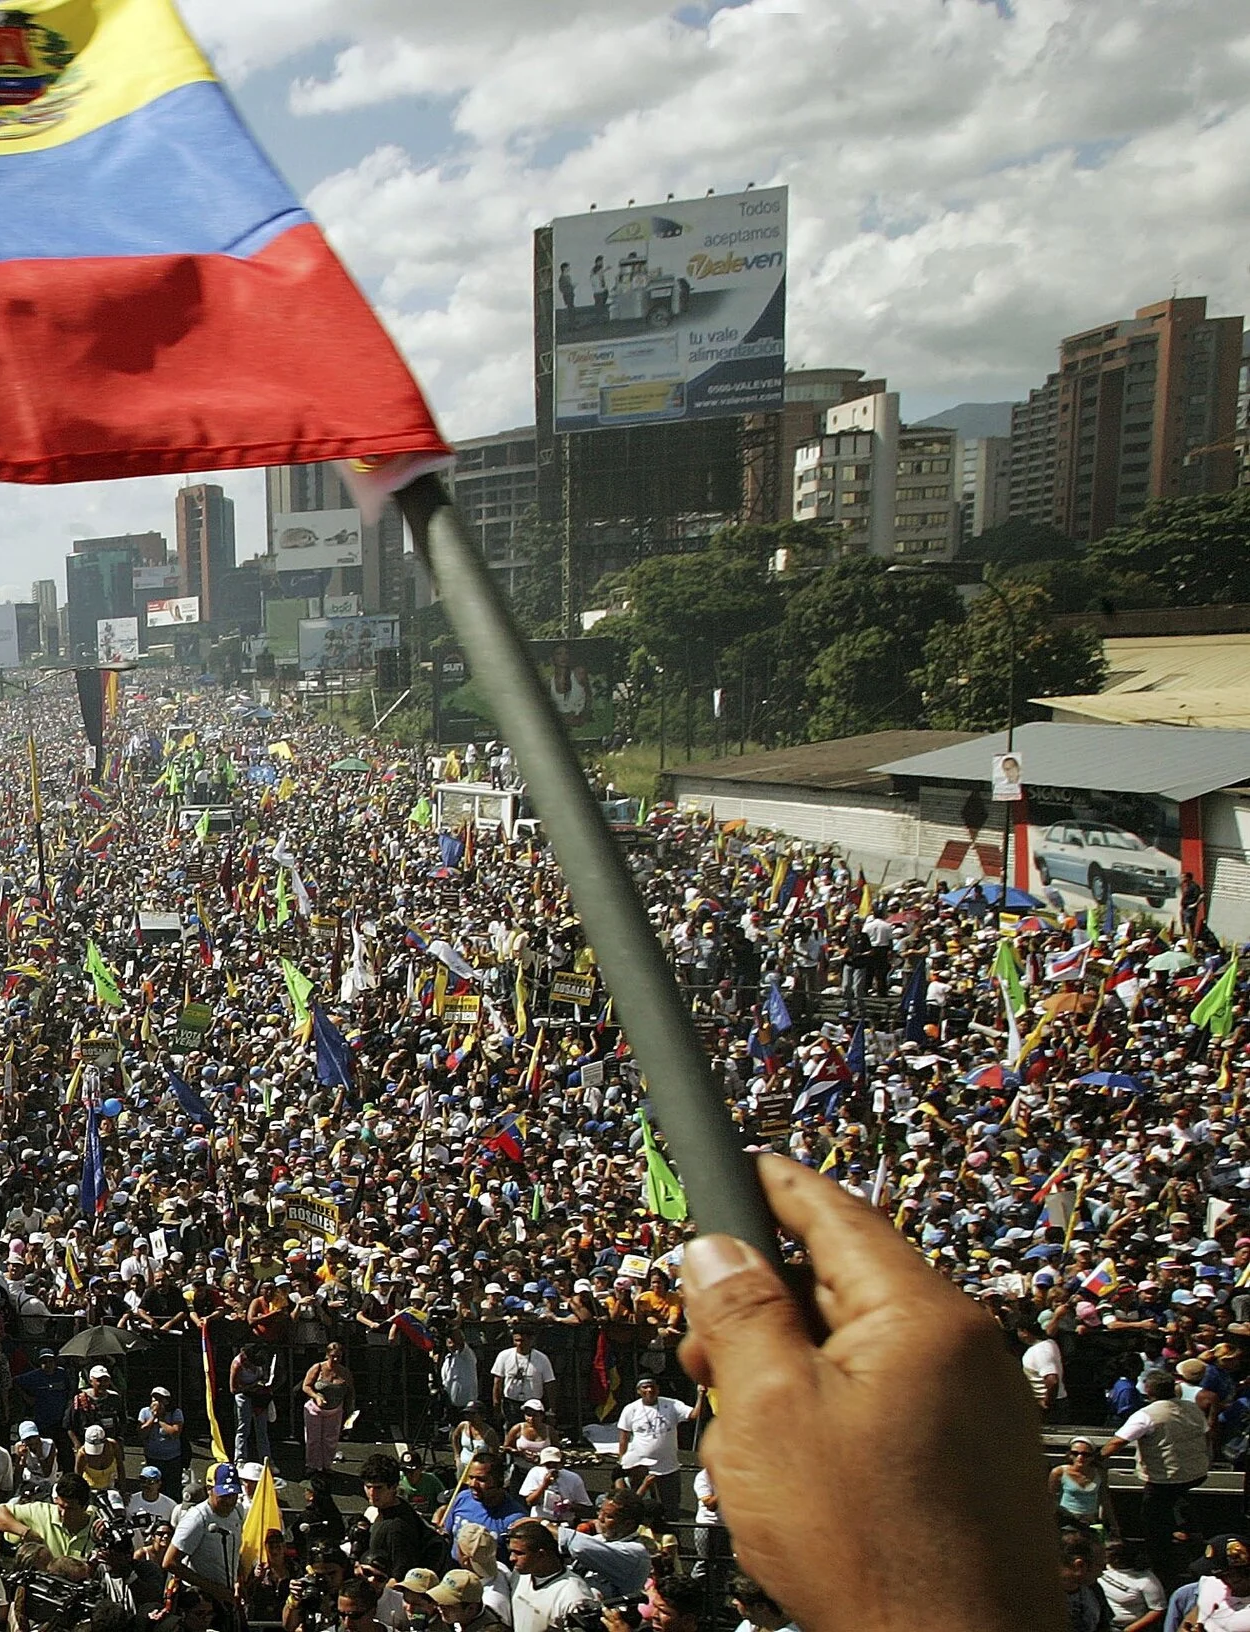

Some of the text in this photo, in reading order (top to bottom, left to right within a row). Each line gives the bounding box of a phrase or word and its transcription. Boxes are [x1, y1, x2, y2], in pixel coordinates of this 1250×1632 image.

[739, 200, 781, 217] Todos
[704, 226, 781, 248] aceptamos
[686, 250, 784, 280] Valeven
[689, 327, 739, 345] tu vale
[688, 336, 783, 363] alimentación
[553, 982, 592, 998] ROSALES
[288, 1207, 336, 1234] ROSALES
